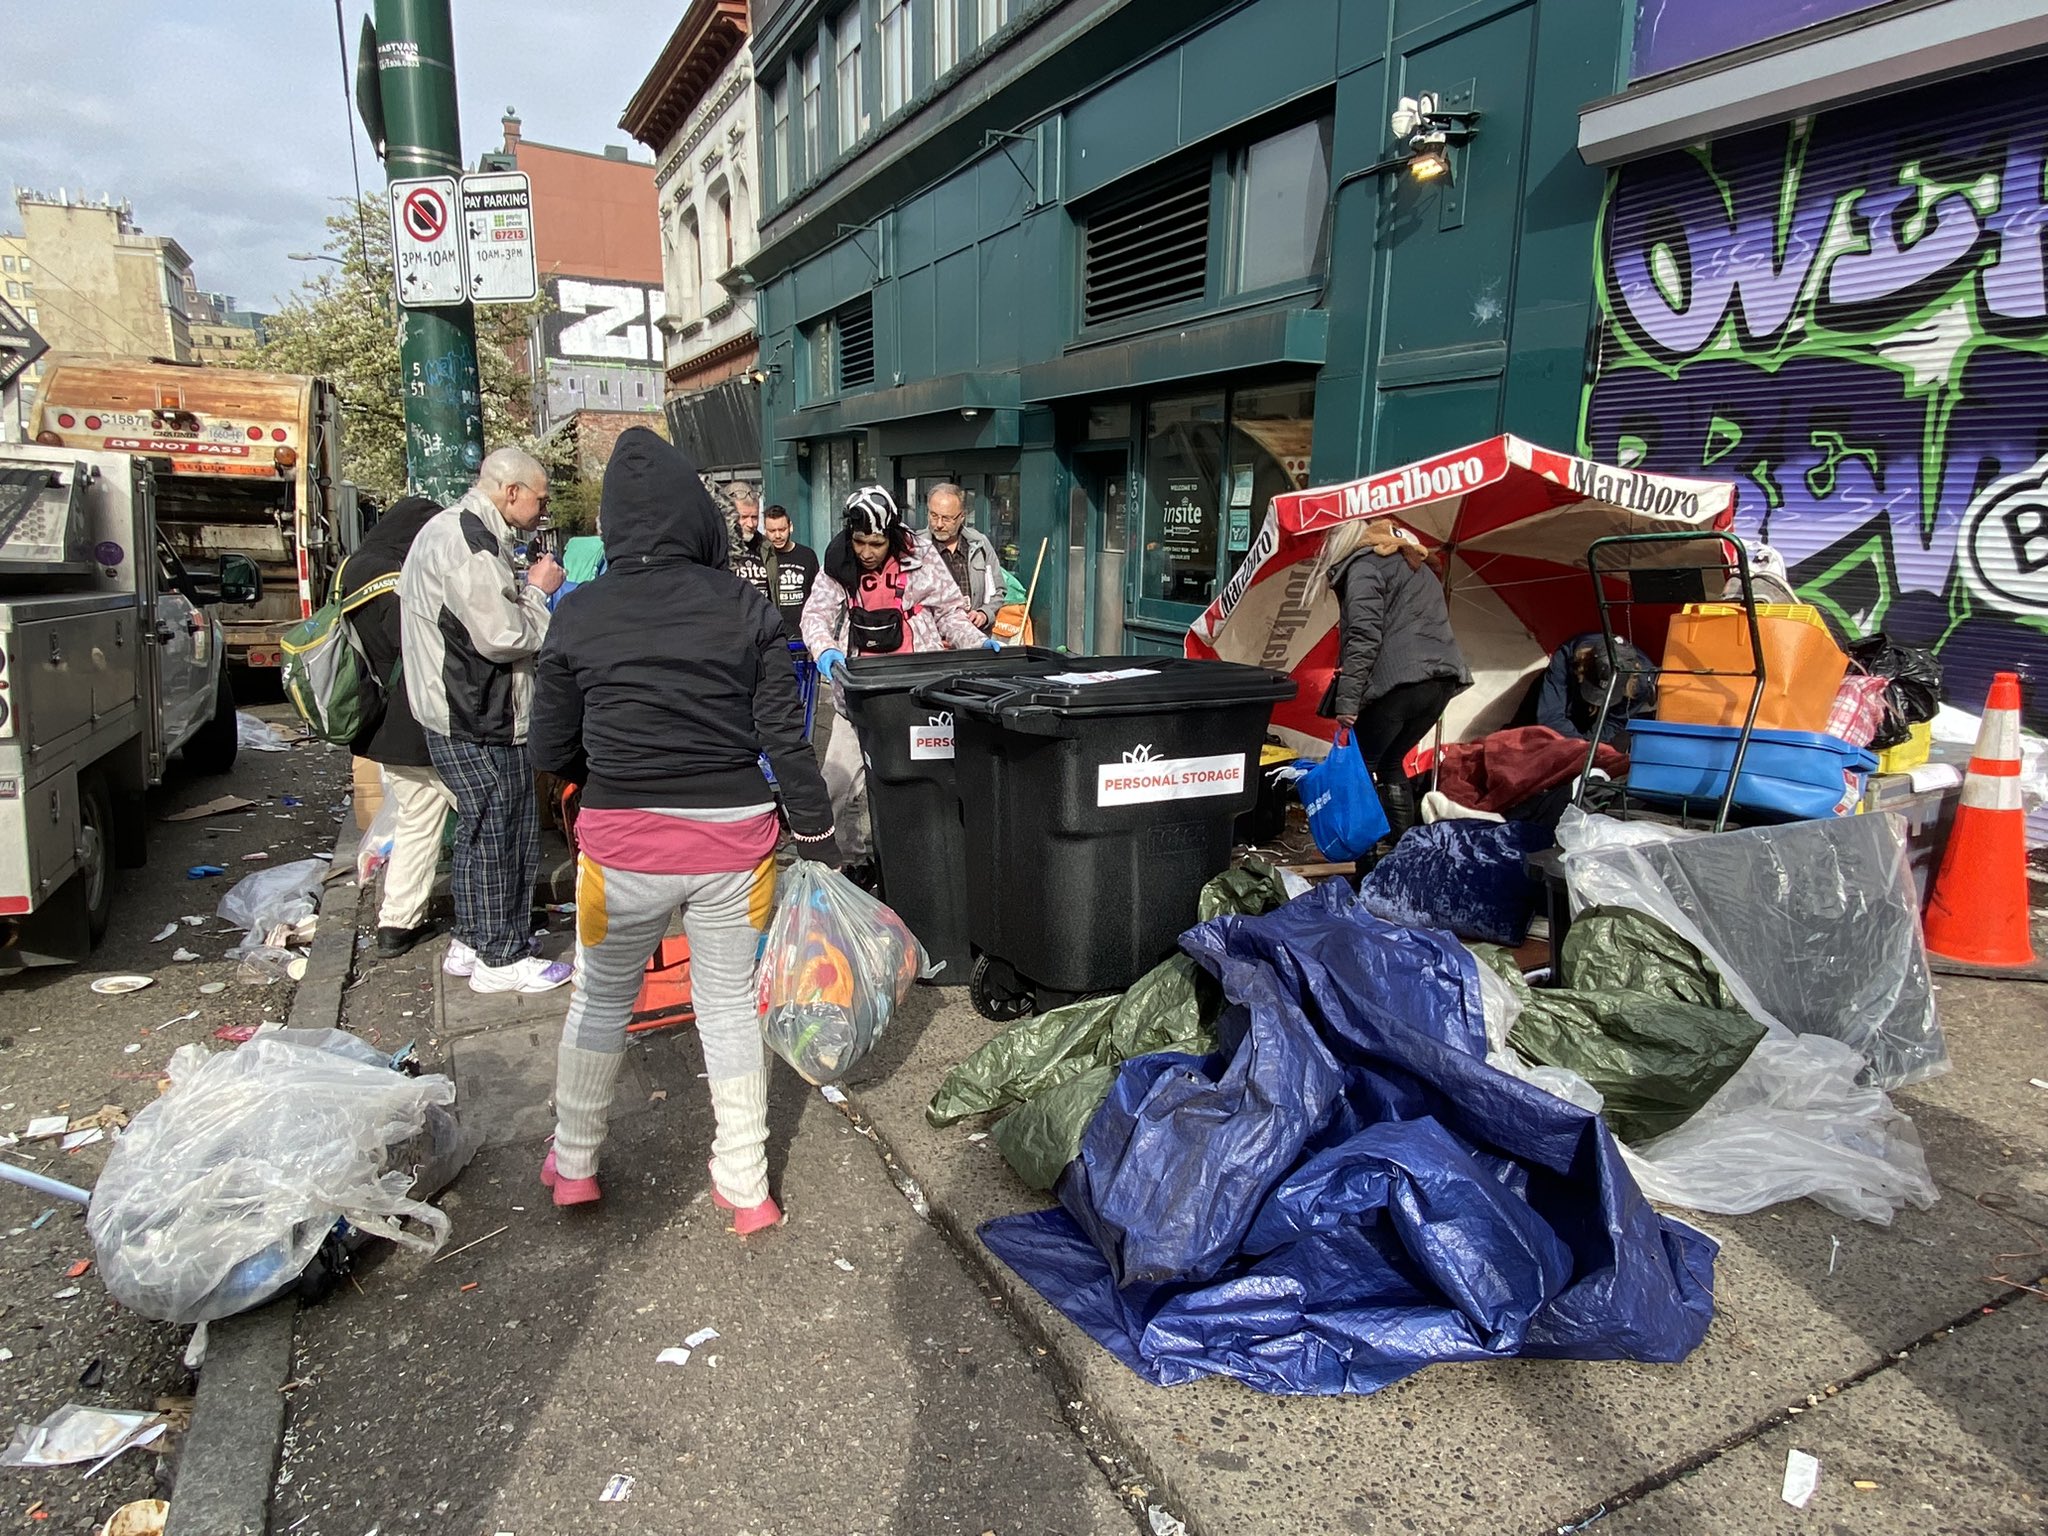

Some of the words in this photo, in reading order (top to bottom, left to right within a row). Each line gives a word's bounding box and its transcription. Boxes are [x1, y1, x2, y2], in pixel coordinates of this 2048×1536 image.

[464, 195, 482, 208] PAY
[484, 192, 528, 207] PARKING
[494, 229, 524, 240] 67213
[150, 441, 189, 451] NOT
[198, 444, 242, 454] PASS
[1344, 457, 1484, 517] Marlboro
[1574, 459, 1699, 518] Marlboro
[1163, 501, 1202, 524] insite
[735, 563, 767, 578] site
[779, 569, 804, 584] site
[1220, 531, 1272, 618] Marlboro
[1104, 774, 1179, 791] PERSONAL
[1181, 768, 1240, 784] STORAGE
